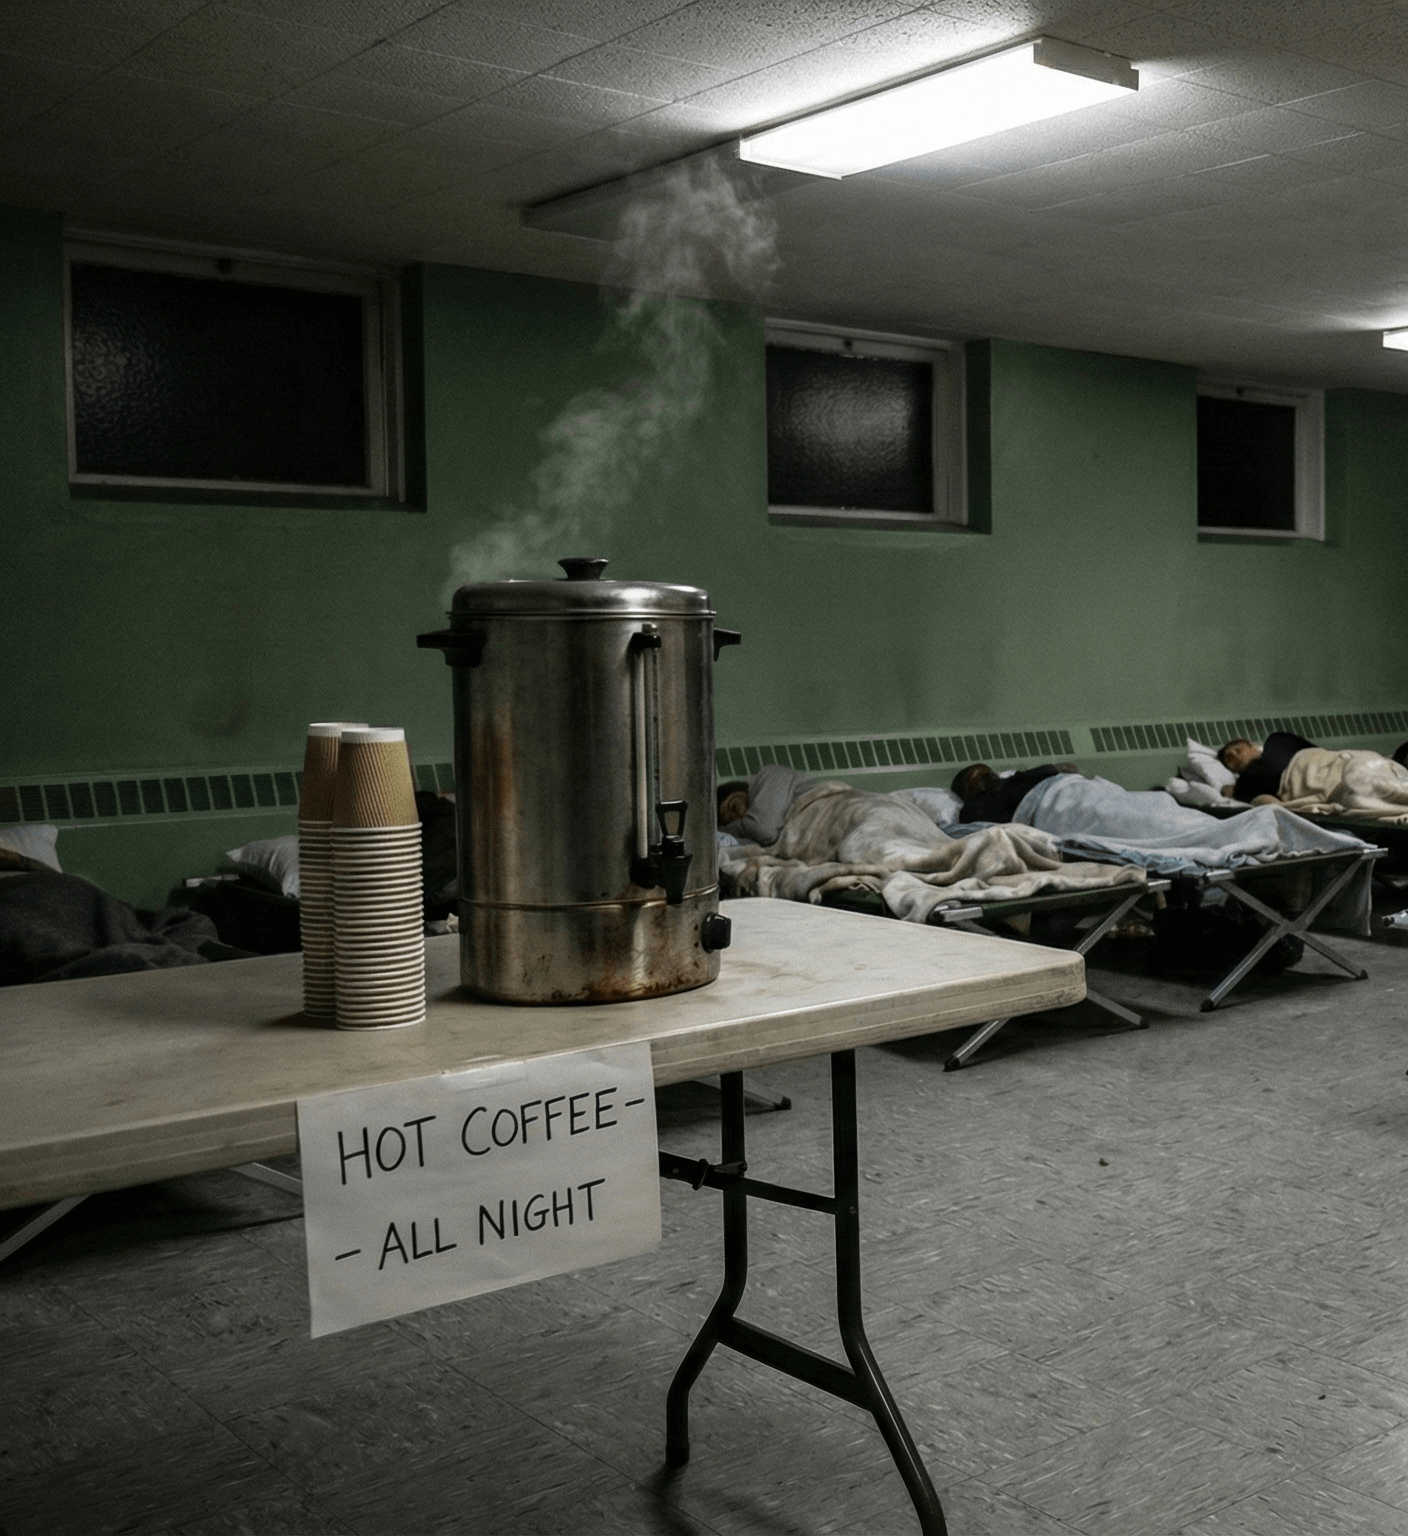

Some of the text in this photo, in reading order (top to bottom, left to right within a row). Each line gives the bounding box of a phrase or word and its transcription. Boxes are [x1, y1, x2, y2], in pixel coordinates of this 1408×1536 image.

[338, 1114, 436, 1185] HOT
[378, 1217, 457, 1270] ALL
[479, 1178, 606, 1246] NIGHT
